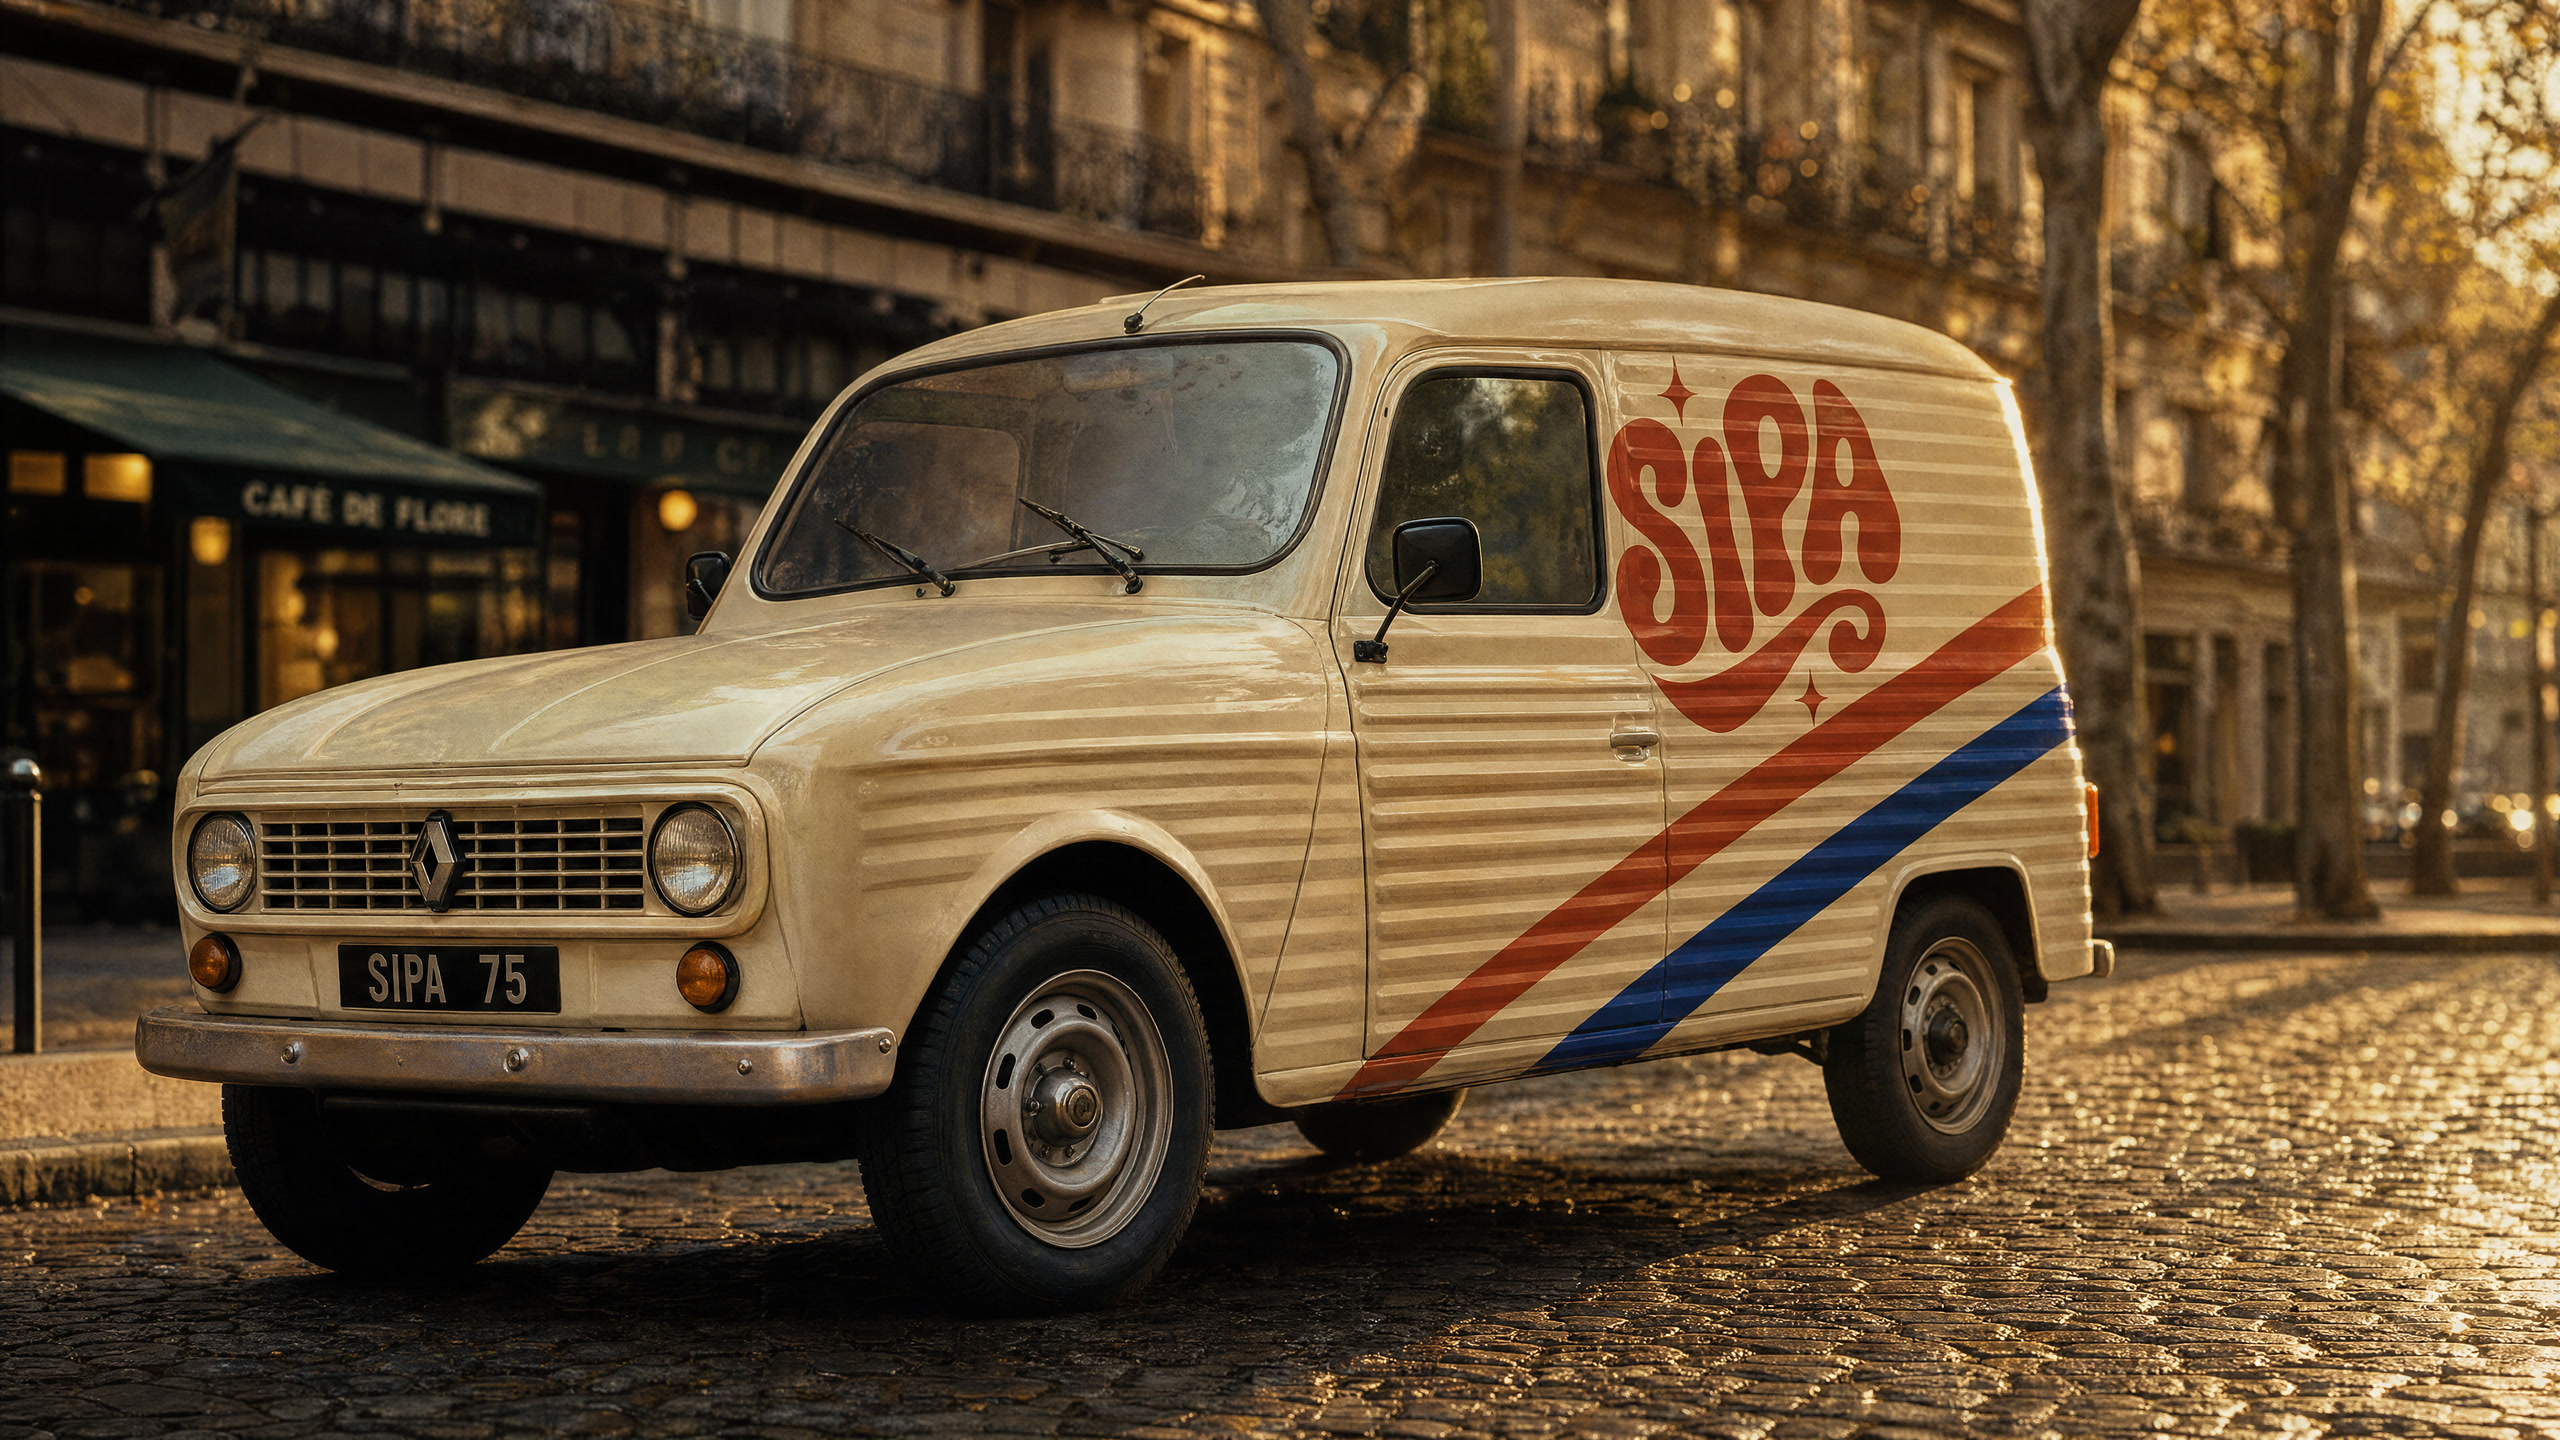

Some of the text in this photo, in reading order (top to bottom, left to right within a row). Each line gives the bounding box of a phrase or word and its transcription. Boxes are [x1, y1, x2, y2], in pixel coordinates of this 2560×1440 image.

[343, 490, 384, 529] DE
[395, 495, 491, 538] FLORE
[1607, 374, 1901, 667] SIPA
[368, 952, 527, 1005] SIPA 75
